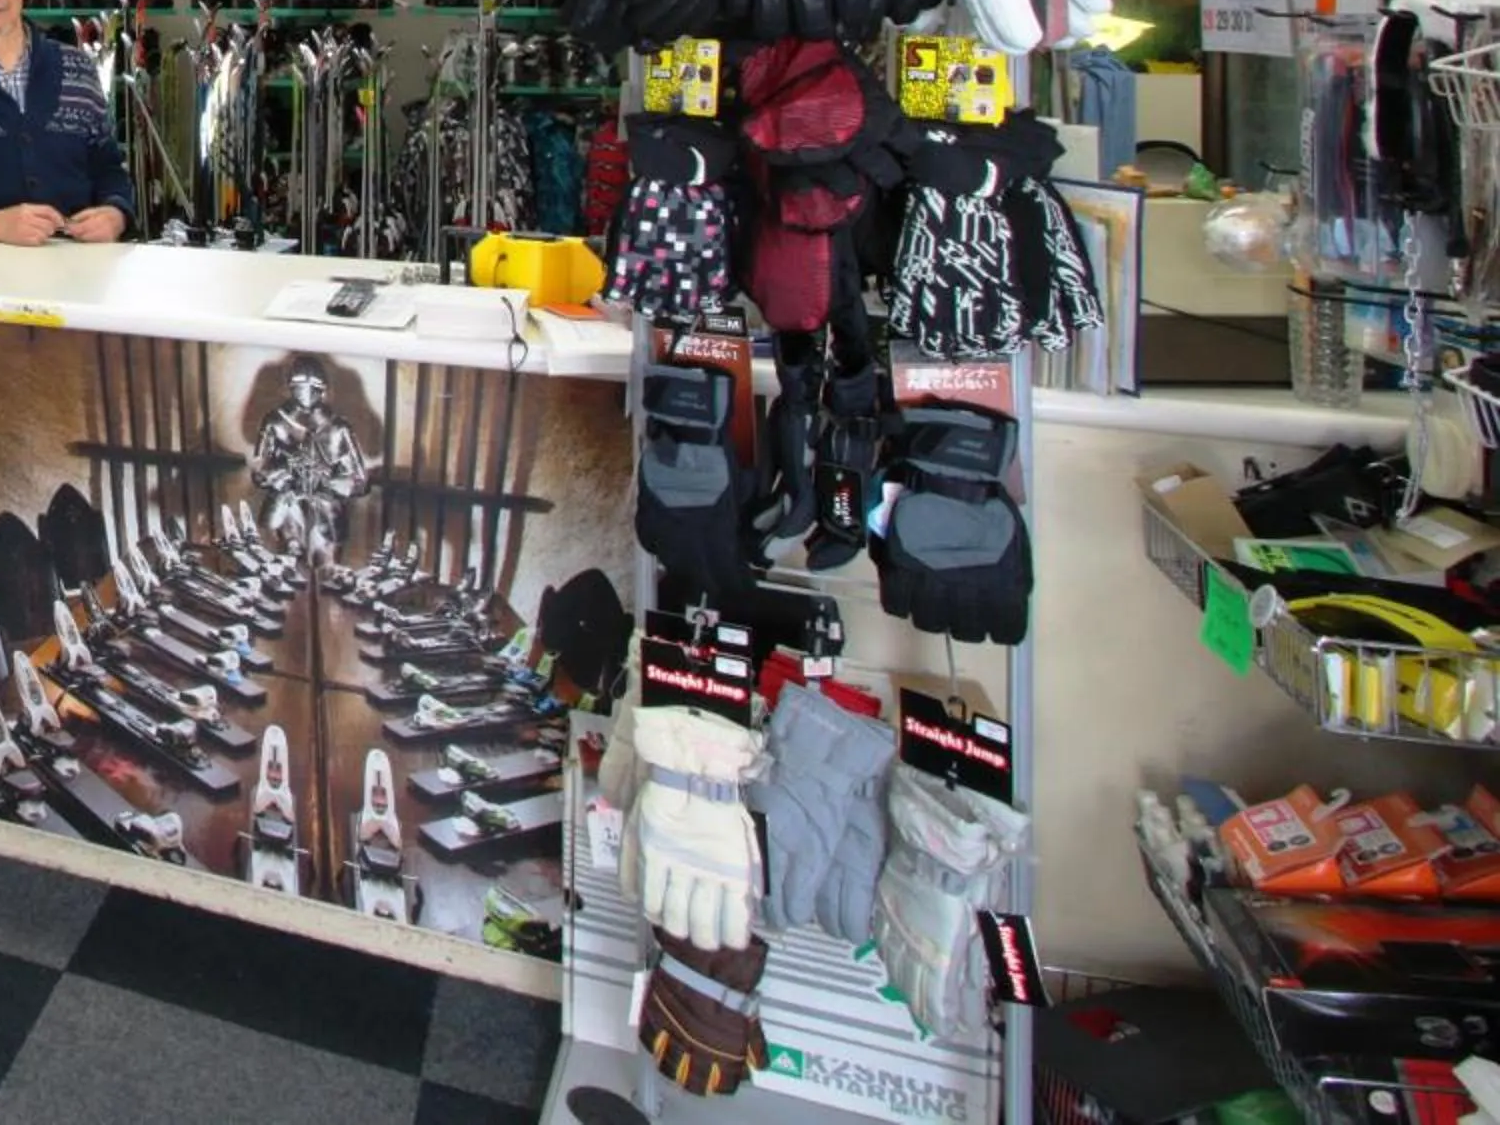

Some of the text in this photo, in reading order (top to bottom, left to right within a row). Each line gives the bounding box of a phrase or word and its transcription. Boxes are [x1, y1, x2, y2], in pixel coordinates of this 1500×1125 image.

[646, 663, 746, 701] Straight Jump
[905, 716, 1006, 768] Straight Jump
